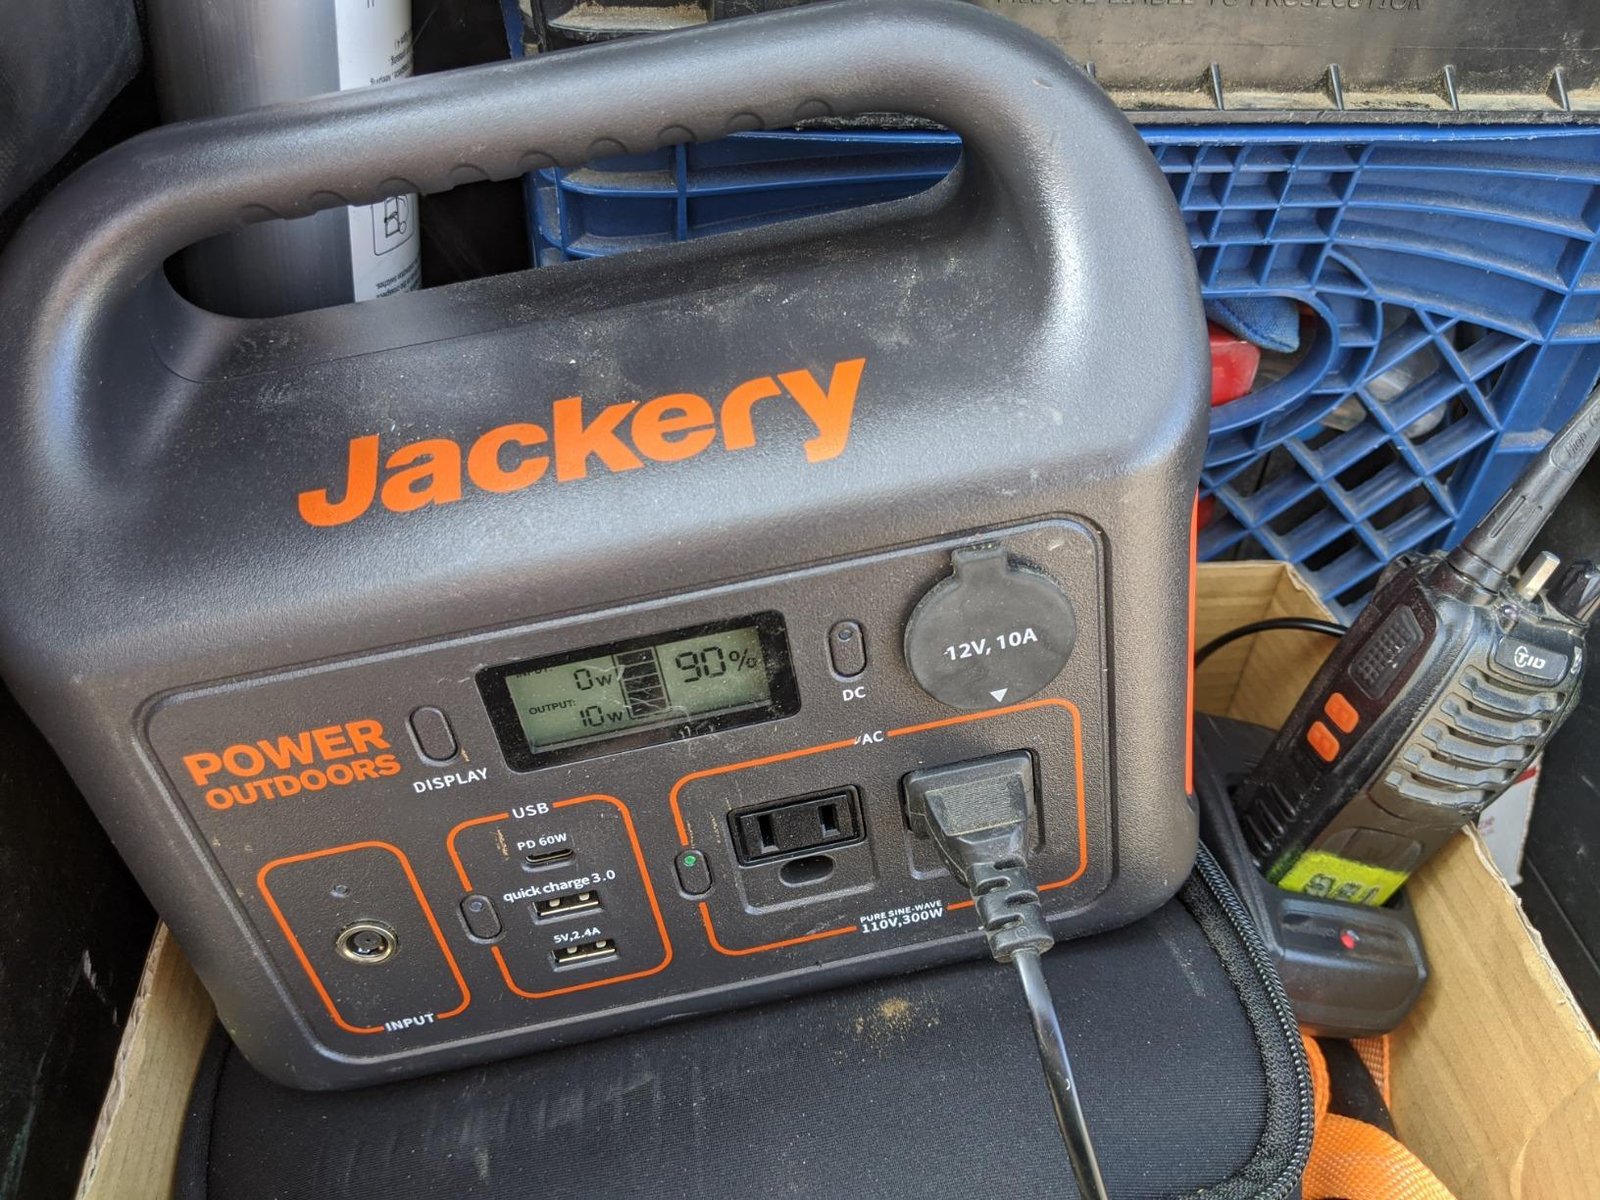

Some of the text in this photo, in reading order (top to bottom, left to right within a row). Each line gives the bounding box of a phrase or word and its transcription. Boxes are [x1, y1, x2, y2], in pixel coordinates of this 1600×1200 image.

[298, 357, 866, 527] Jackery
[946, 627, 1038, 661] 12V, 10A
[675, 645, 757, 684] 90%
[842, 686, 866, 701] DC
[529, 699, 576, 716] OUTPUT:
[861, 730, 884, 746] AC
[183, 719, 391, 786] POWER
[205, 754, 401, 811] OUTDOORS
[412, 767, 488, 794] DISPLAY
[512, 802, 550, 819] USB
[517, 833, 568, 851] PD 60W
[503, 870, 616, 904] quick charge 3.0
[860, 900, 943, 924] PURE SINE-WAVE
[861, 907, 944, 934] 110V,300W
[553, 926, 601, 944] 5V,2.4A
[385, 1013, 435, 1033] INPUT
